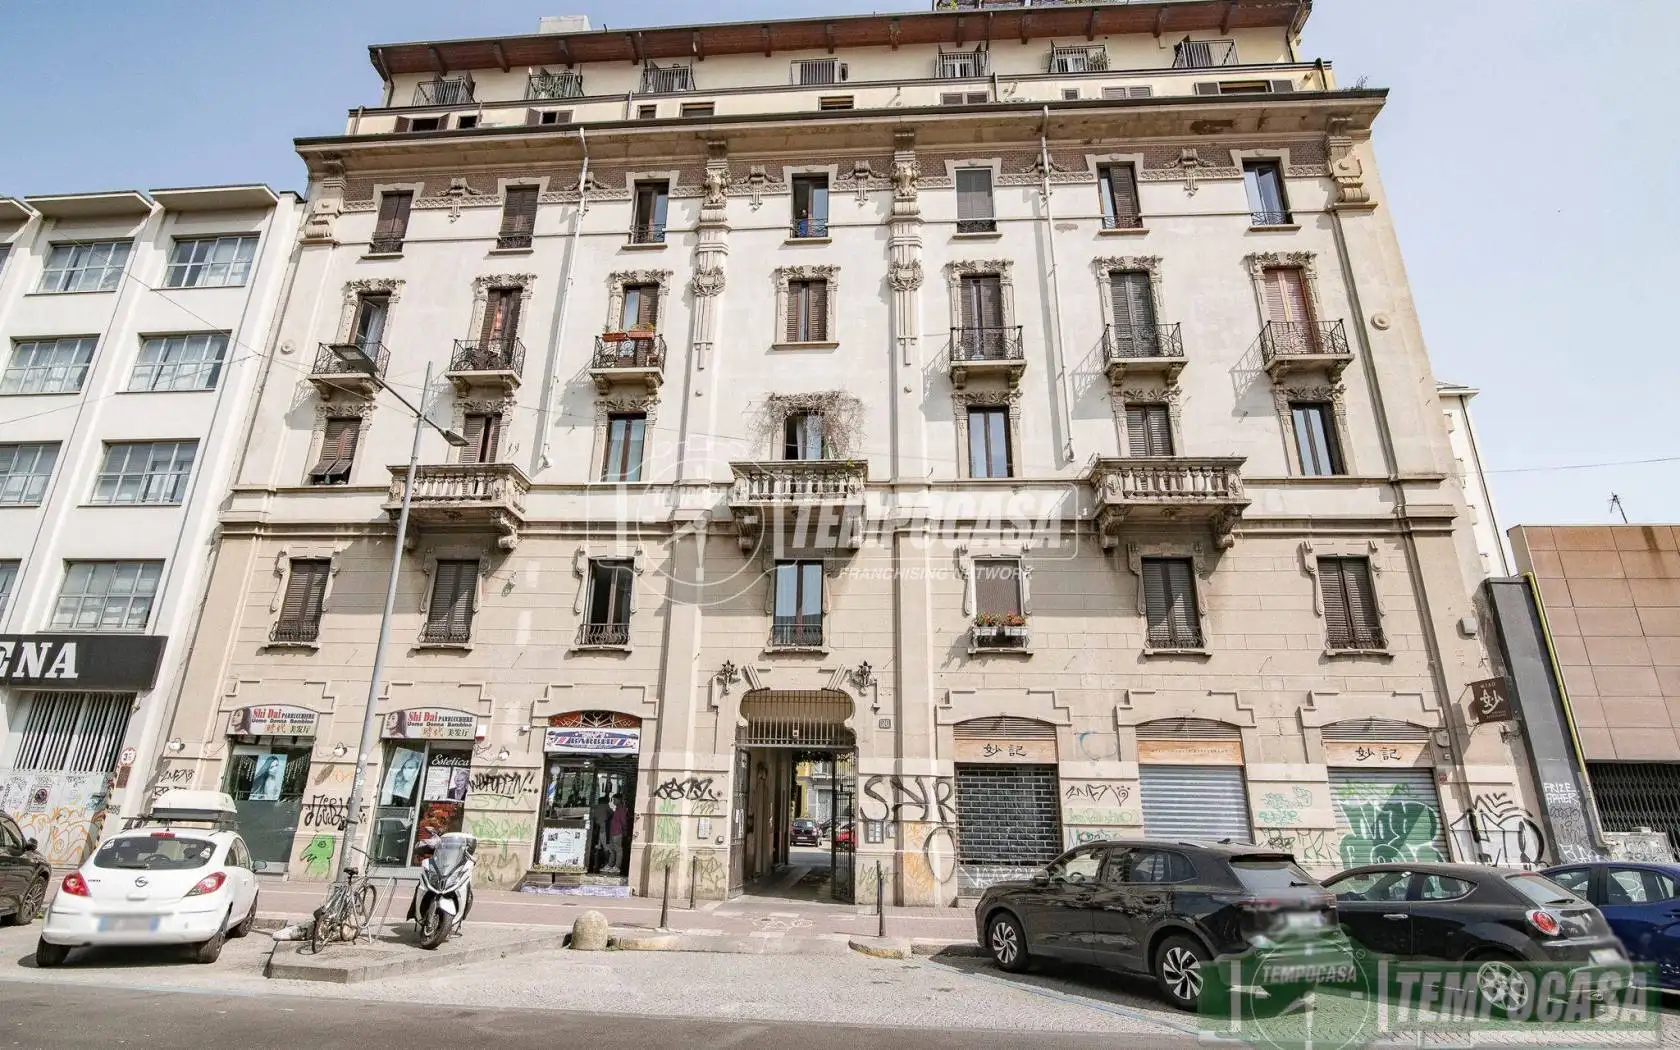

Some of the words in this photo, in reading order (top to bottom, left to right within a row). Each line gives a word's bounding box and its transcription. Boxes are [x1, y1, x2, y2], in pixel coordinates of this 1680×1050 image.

[1479, 688, 1504, 715] 妙
[253, 708, 266, 719] Shi
[267, 708, 282, 719] Dai
[408, 711, 421, 722] Shi
[423, 711, 438, 722] Dai
[431, 753, 471, 766] Estetica
